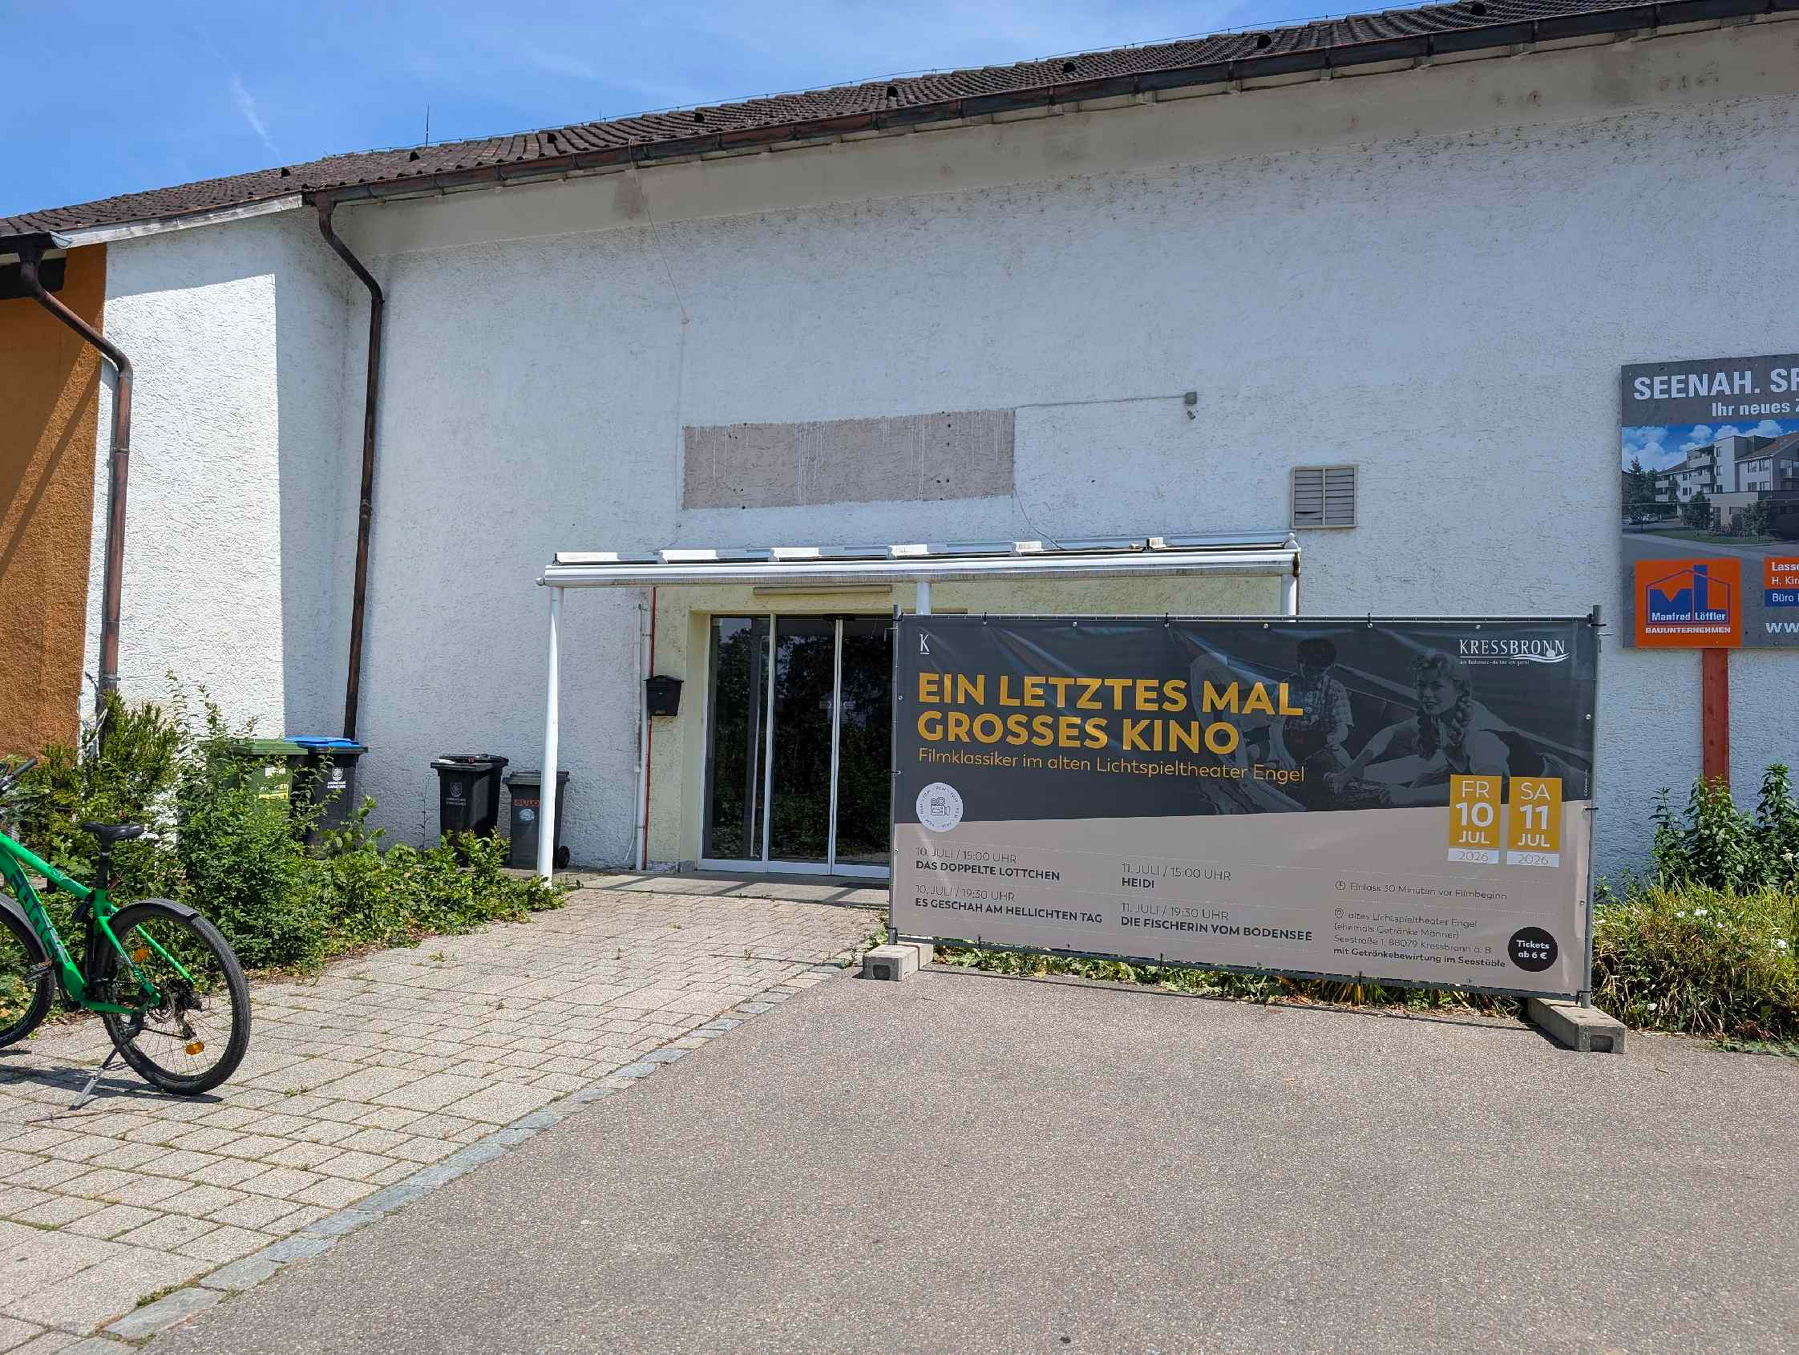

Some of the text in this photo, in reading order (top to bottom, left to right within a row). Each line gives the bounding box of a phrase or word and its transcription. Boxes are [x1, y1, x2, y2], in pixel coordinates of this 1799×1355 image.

[1633, 371, 1760, 400] SEENAH.
[1711, 402, 1735, 417] Ihr
[1739, 402, 1790, 415] neues
[1771, 561, 1799, 571] Lass
[1772, 593, 1794, 602] Büro
[1651, 611, 1726, 621] Manfred Löffler
[1460, 640, 1565, 655] KRESSBRONN
[919, 672, 1303, 715] EIN LETZTES MAL
[918, 711, 1239, 754] GROSSES KINO
[919, 747, 1304, 784] Filmklassiker im alten Lichtspieltheater Engel
[1462, 780, 1490, 798] FR
[1520, 782, 1551, 800] SA
[1456, 802, 1494, 827] 10
[1520, 804, 1549, 829] 11
[1459, 830, 1490, 844] JUL
[1518, 833, 1550, 847] JUL
[915, 847, 930, 857] 10.
[932, 848, 953, 858] JULI
[963, 850, 990, 861] 15:00
[992, 853, 1017, 864] UHR
[1458, 851, 1489, 862] 2026
[1519, 854, 1549, 865] 2026
[916, 860, 1060, 881] DAS DOPPELTE LOTTCHEN
[1122, 863, 1134, 873] 11.
[1136, 864, 1159, 876] JULI
[1171, 867, 1201, 879] 15:00
[1204, 869, 1232, 881] UHR
[1121, 877, 1155, 888] HEIDI
[915, 885, 929, 895] 10.
[931, 886, 952, 897] JULI
[962, 888, 988, 900] 19:30
[991, 891, 1015, 902] UHR
[1350, 882, 1508, 901] Einlass 30 Minuten vor Filmbeginn
[915, 898, 1103, 923] ES GESCHAH AM HELLICHTEN TAG
[1121, 903, 1133, 913] 11.
[1135, 903, 1159, 915] JULI
[1171, 906, 1199, 918] 19:30
[1202, 909, 1229, 921] UHR
[1121, 916, 1313, 941] DIE FISCHERIN VOM BODENSEE
[1348, 911, 1477, 929] altes Lichtspieltheater Engel
[1334, 922, 1375, 933] (ehemals
[1421, 929, 1459, 939] Männer)
[1334, 935, 1378, 945] Seestraße
[1389, 939, 1418, 948] 88079
[1420, 941, 1471, 952] Kressbronn
[1516, 939, 1550, 949] Tickets
[1333, 947, 1349, 955] mit
[1351, 948, 1442, 964] Getränkebewirtung
[1458, 956, 1506, 967] Seestüble
[1539, 952, 1548, 960] €
